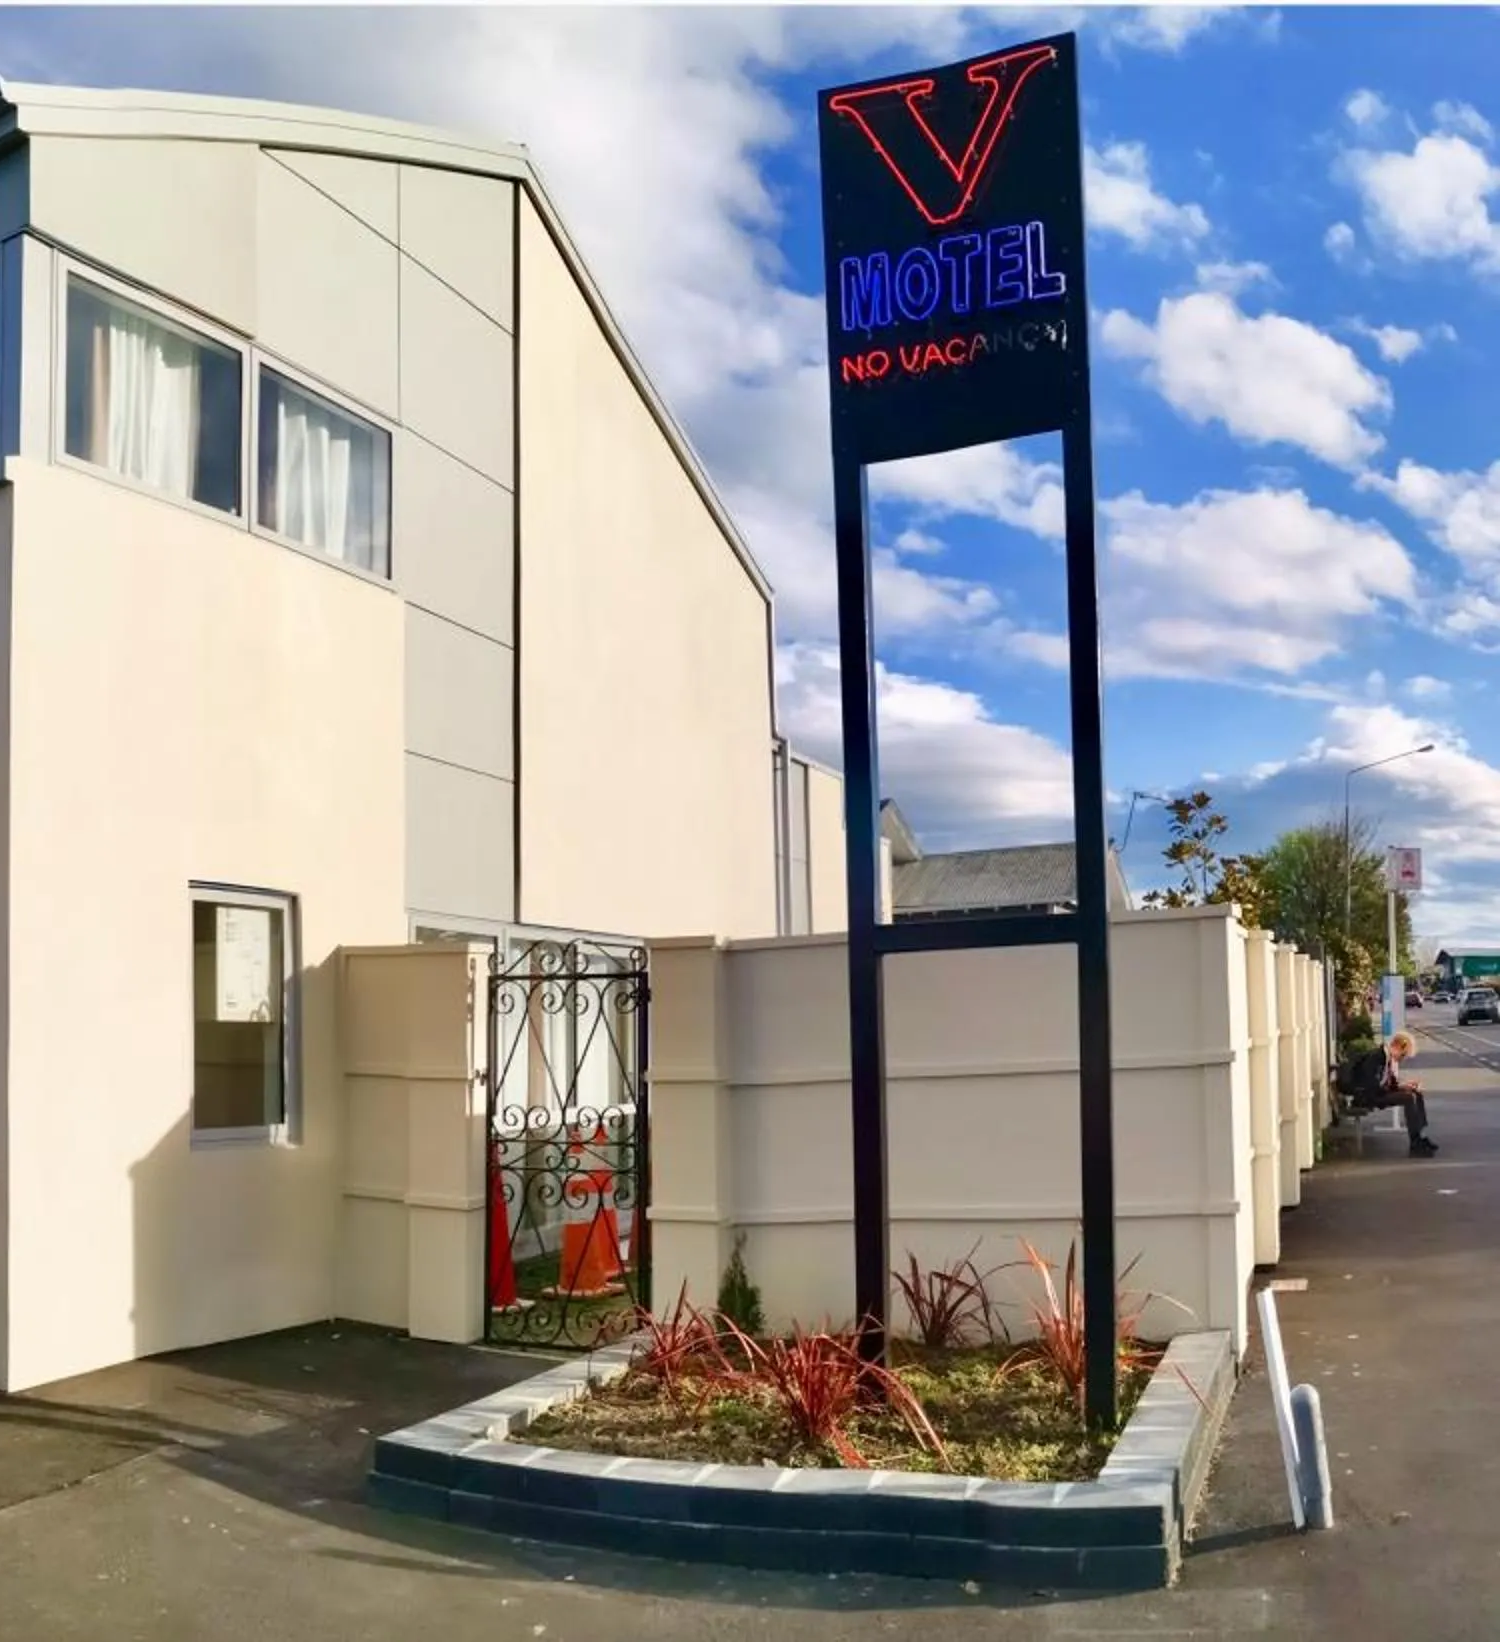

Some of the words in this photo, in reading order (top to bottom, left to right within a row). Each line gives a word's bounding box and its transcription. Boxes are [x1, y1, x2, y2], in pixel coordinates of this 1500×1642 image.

[830, 45, 1056, 225] V
[839, 221, 1067, 331] MOTEL
[841, 350, 890, 384] NO
